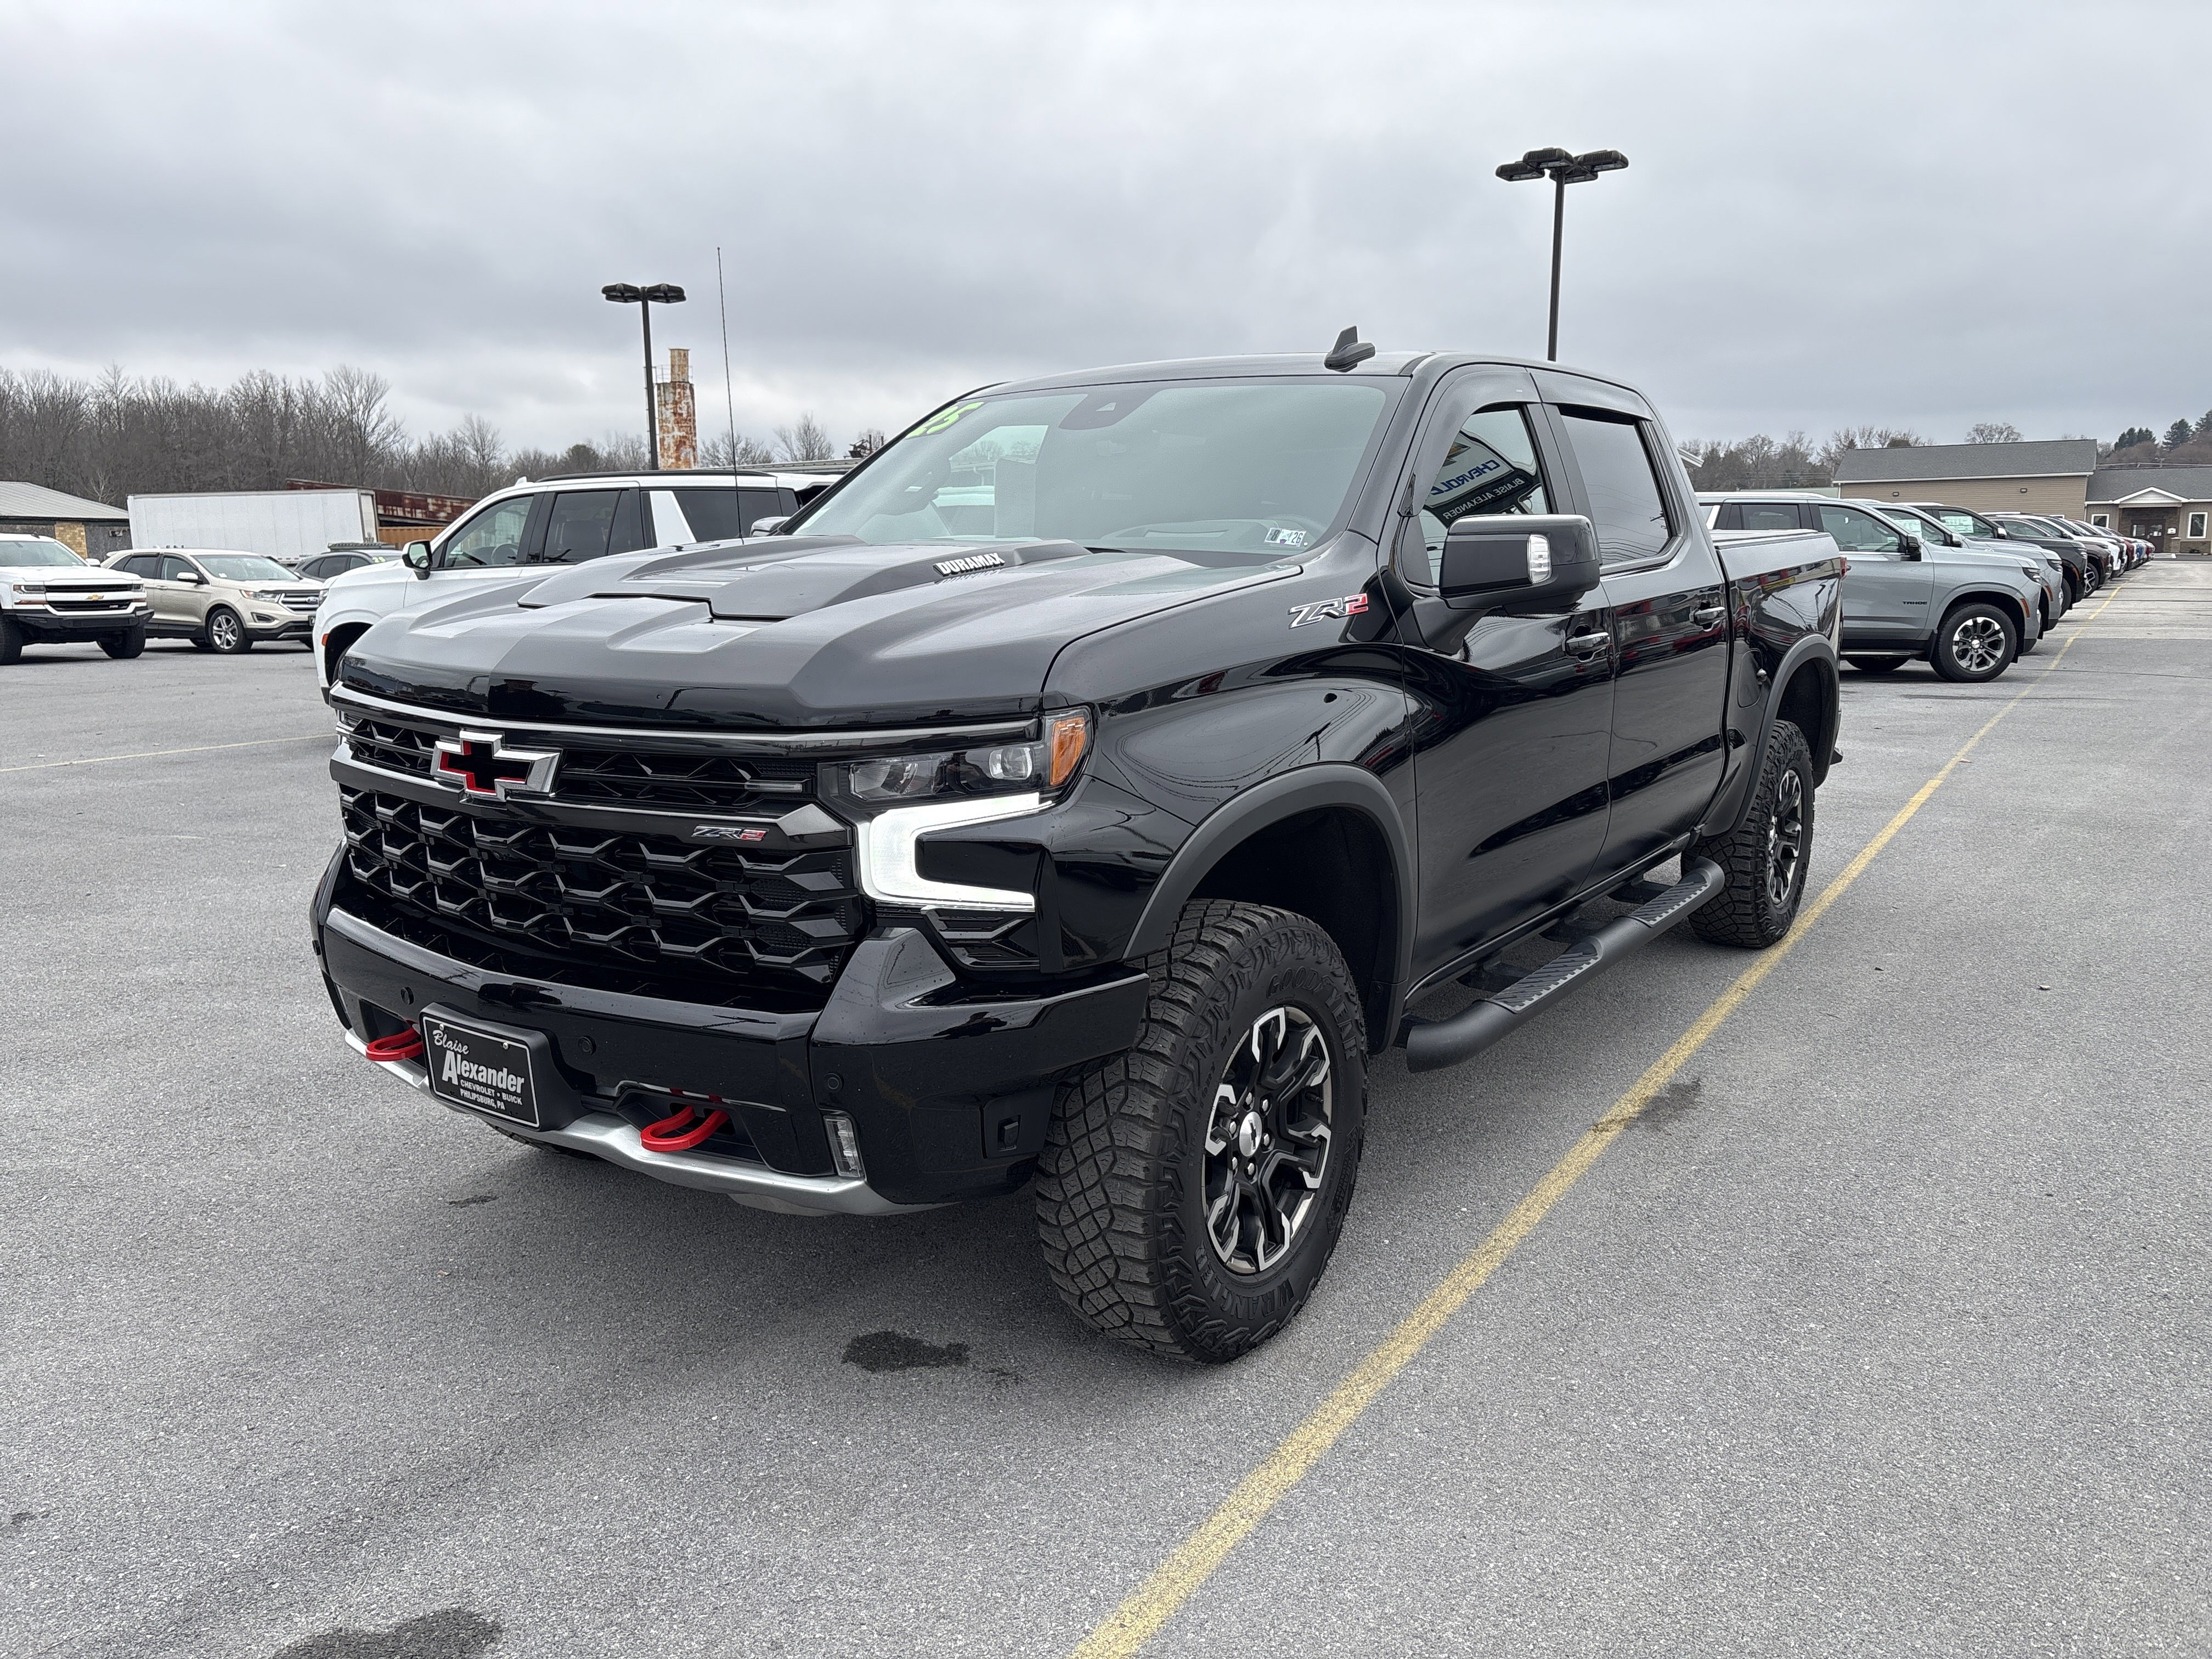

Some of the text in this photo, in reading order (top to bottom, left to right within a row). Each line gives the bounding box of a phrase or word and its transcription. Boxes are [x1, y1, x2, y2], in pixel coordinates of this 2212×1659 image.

[905, 402, 984, 438] 25
[1290, 532, 1304, 544] 26
[934, 552, 1006, 576] DURAMAX
[1288, 593, 1369, 629] ZR2
[691, 824, 769, 842] ZR2
[1266, 966, 1358, 1061] GOODYEAR
[432, 1029, 470, 1054] Blaise
[442, 1049, 524, 1093] Alexander
[460, 1079, 523, 1105] CHEVROLET BUICK
[460, 1088, 506, 1110] PHILIPSBURG, PA
[1194, 1240, 1295, 1320] WRANGLER
